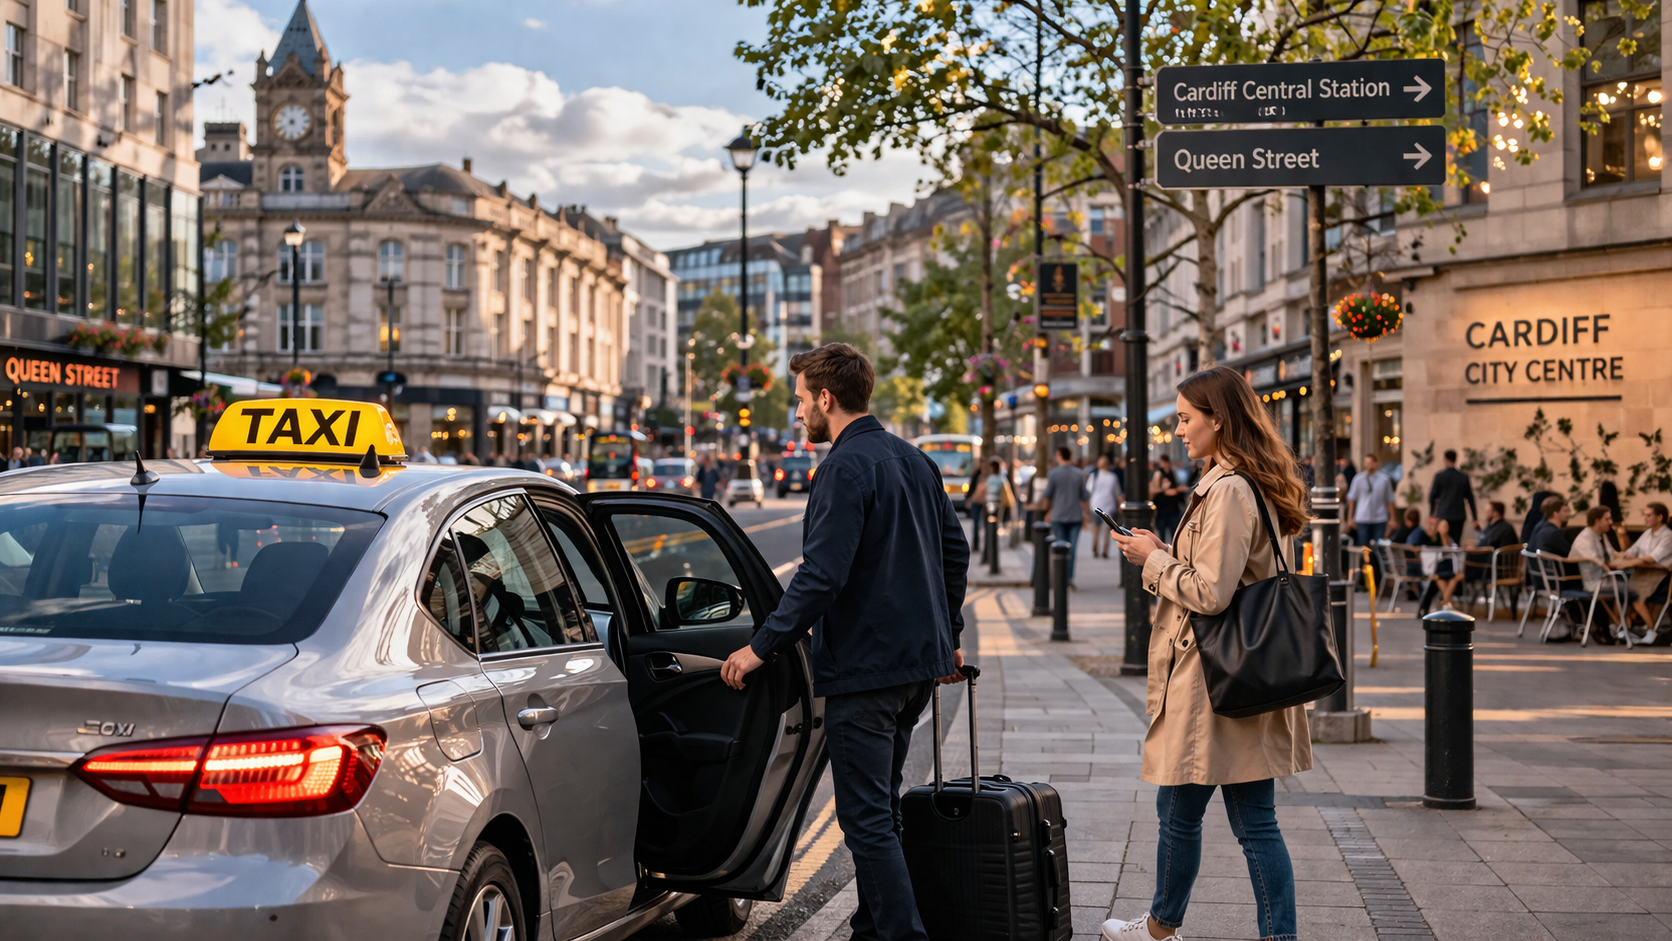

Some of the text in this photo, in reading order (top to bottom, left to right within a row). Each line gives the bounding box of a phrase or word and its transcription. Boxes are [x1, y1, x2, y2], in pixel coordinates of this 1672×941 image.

[1174, 78, 1390, 101] Cardiff Central Station
[1174, 148, 1320, 173] Queen Street
[1466, 314, 1610, 349] CARDIFF
[5, 357, 120, 389] QUEEN STREET
[1465, 356, 1623, 385] CITY CENTRE
[241, 408, 361, 447] TAXI
